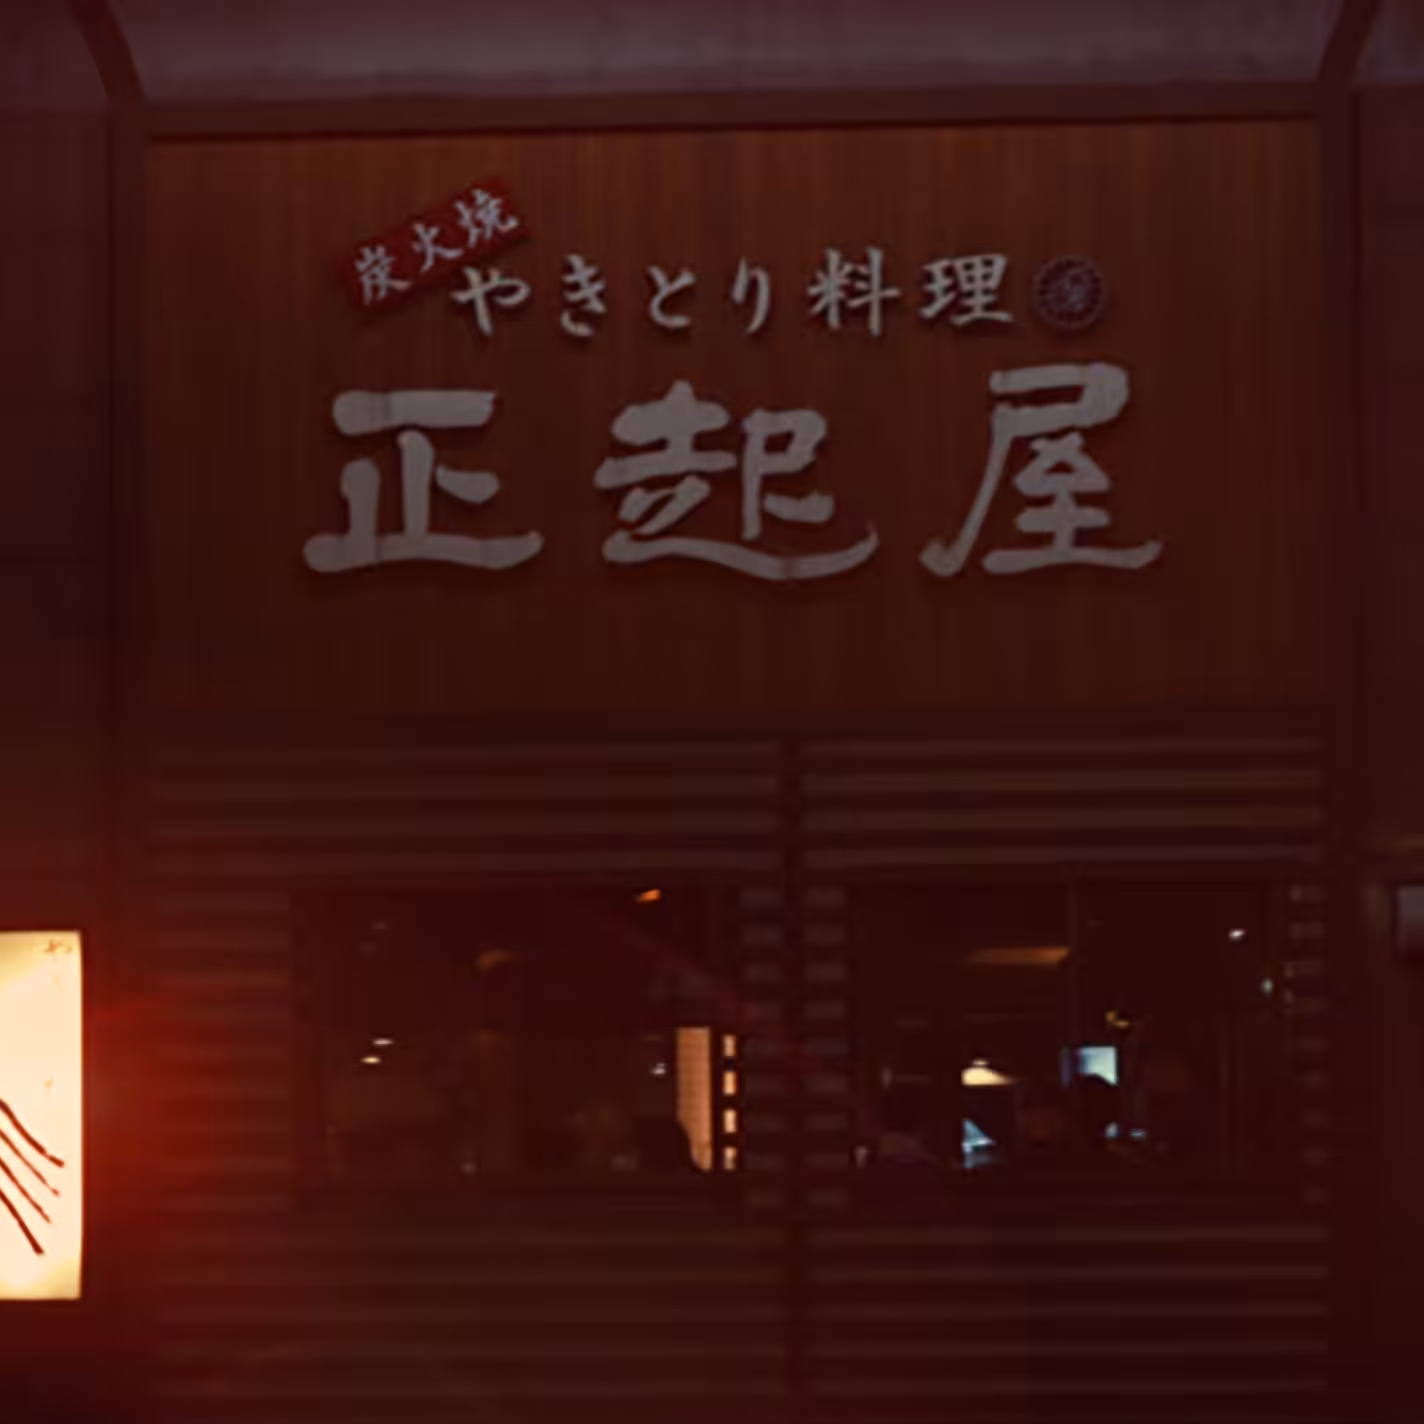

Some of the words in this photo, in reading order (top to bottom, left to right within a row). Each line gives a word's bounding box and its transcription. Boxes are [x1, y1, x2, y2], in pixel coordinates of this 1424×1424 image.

[354, 187, 520, 305] 炭火焼
[451, 246, 1016, 336] やきとり料理
[302, 361, 1163, 580] 正起屋
